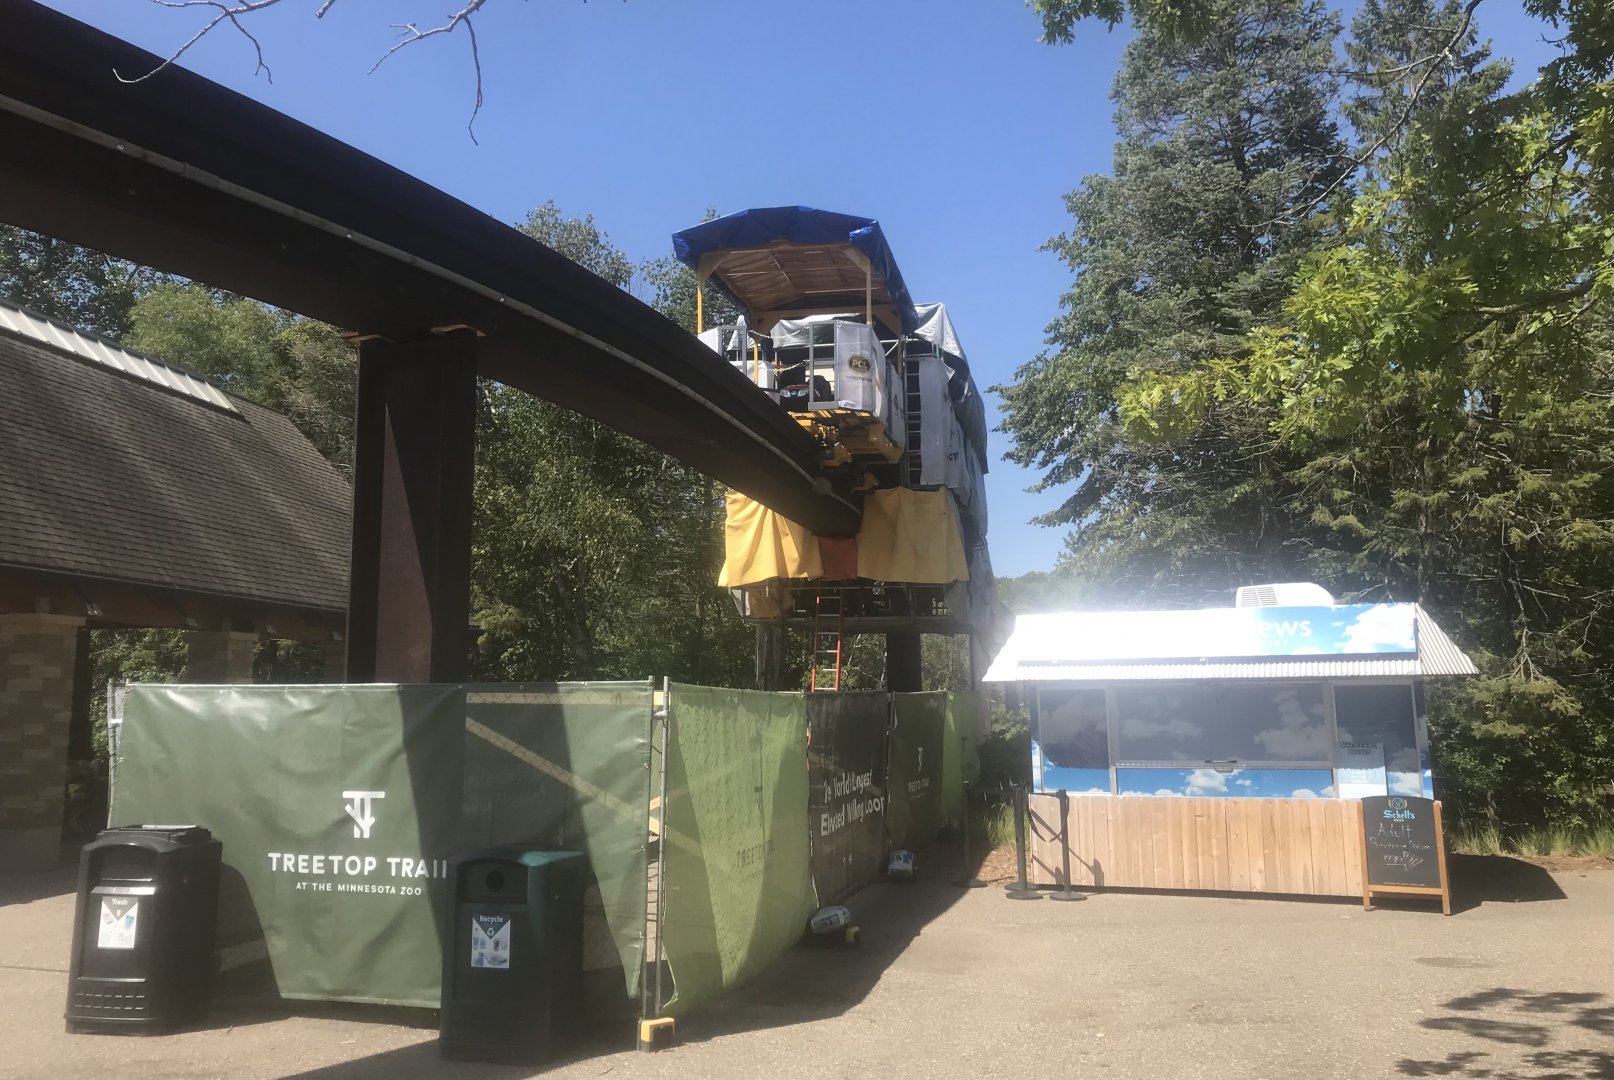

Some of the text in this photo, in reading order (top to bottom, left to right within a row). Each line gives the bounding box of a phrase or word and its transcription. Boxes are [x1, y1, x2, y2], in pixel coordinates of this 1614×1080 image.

[851, 359, 868, 370] PCL
[1383, 809, 1416, 820] Schell's
[267, 852, 378, 876] TREETOP
[295, 882, 422, 896] AT THE MINNESOTA ZOO
[112, 898, 128, 906] Trash
[480, 914, 504, 924] Recycle
